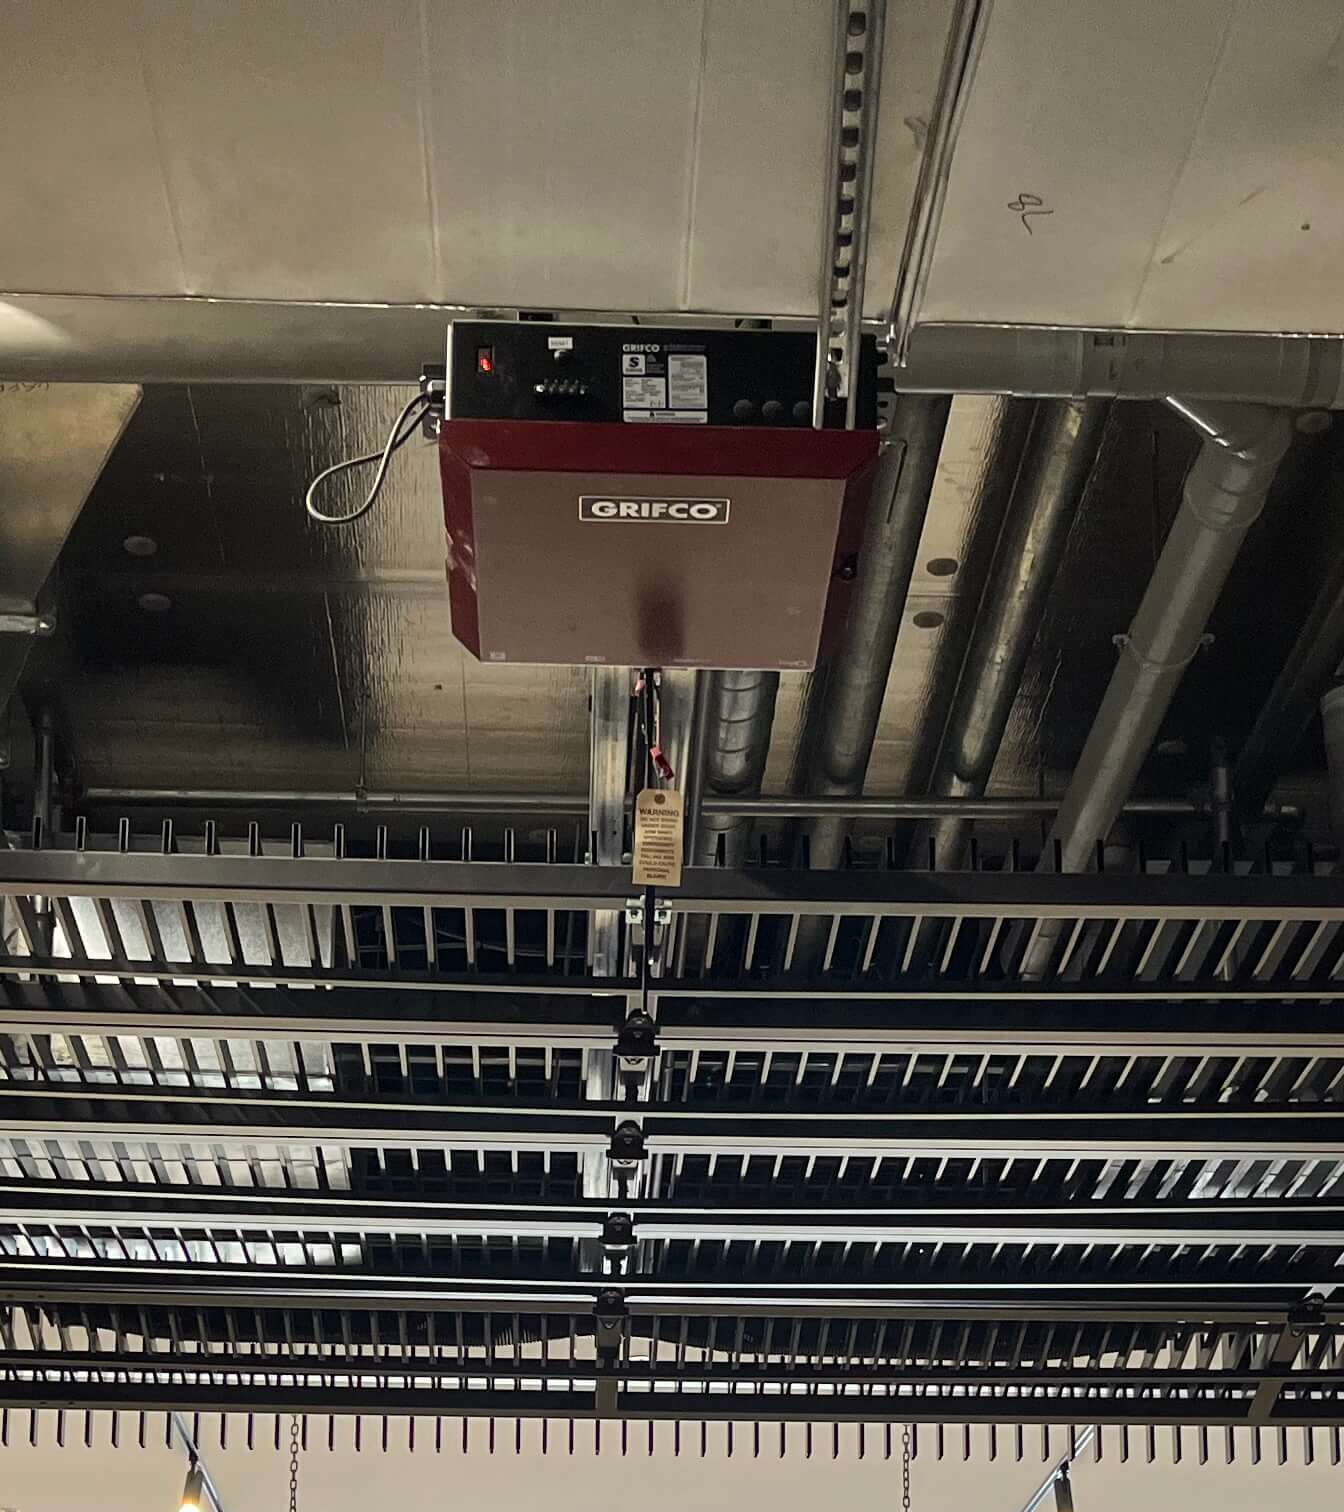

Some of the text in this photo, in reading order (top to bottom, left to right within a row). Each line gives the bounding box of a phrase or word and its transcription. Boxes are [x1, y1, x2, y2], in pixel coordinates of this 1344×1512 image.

[622, 344, 660, 352] GRIFCO
[591, 500, 718, 519] GRIFCO
[639, 808, 680, 817] WARNING
